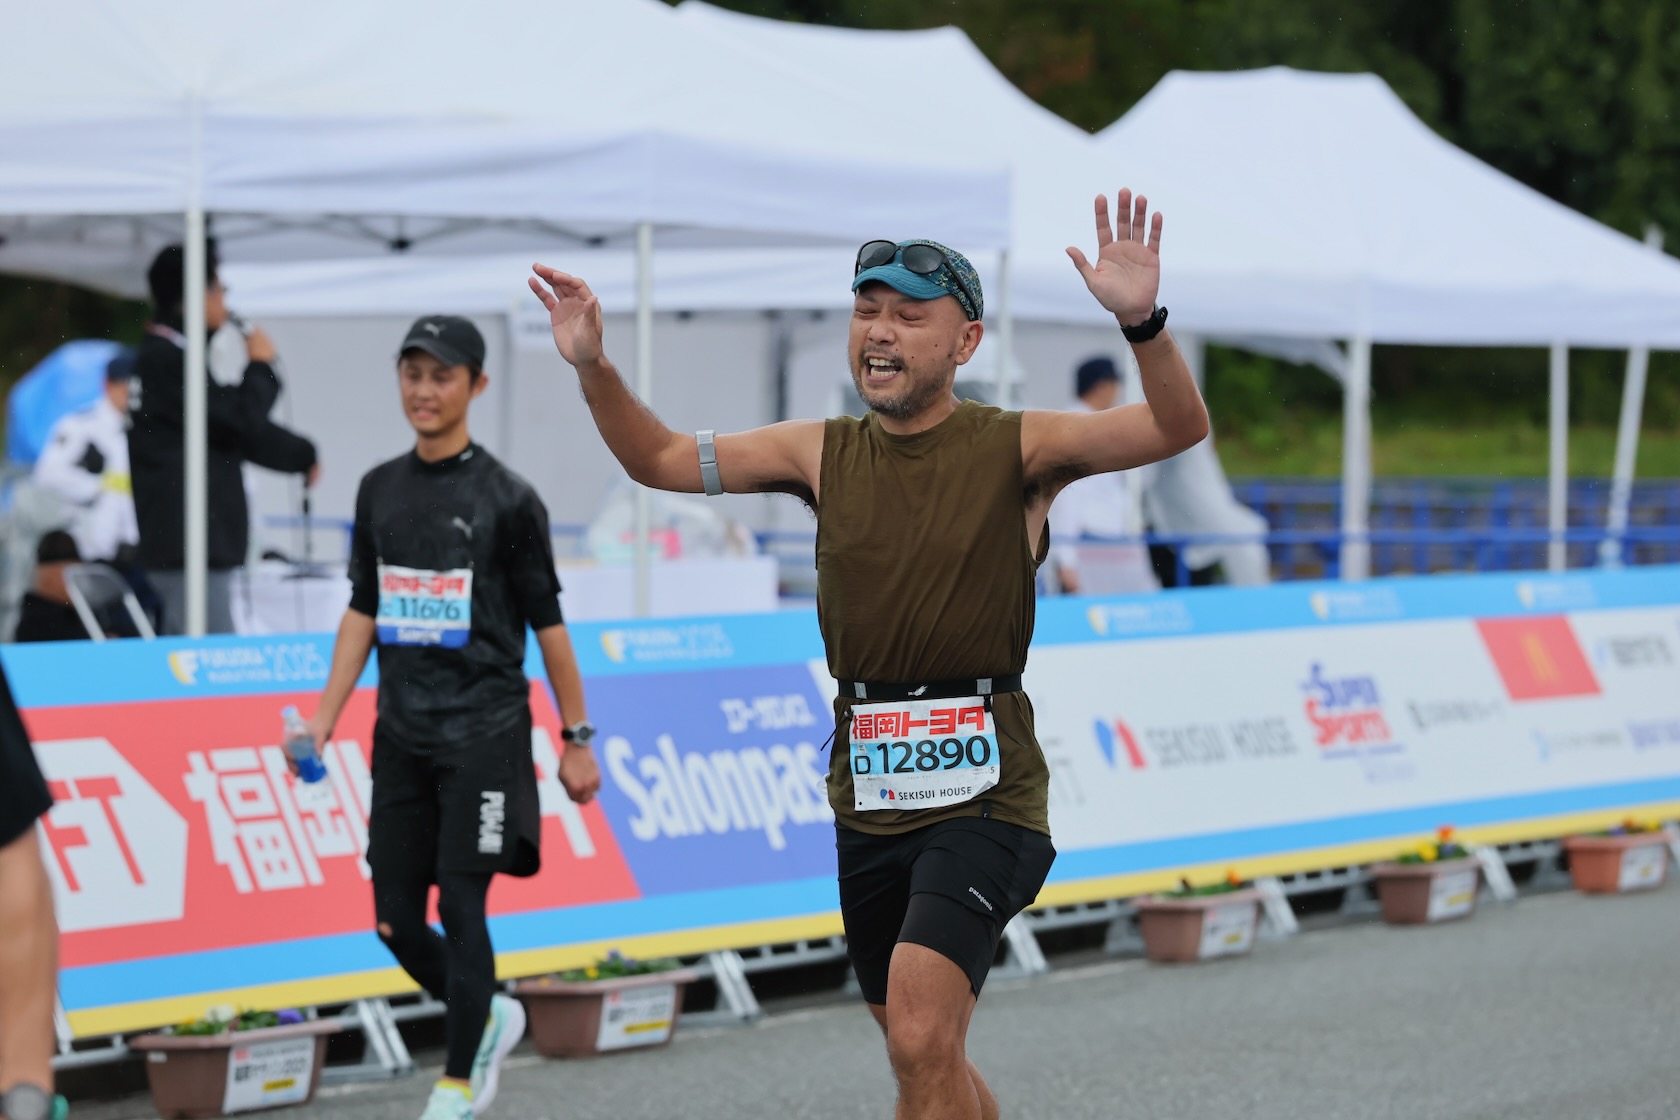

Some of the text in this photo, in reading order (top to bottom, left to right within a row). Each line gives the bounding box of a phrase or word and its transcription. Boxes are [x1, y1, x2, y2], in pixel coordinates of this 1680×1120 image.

[852, 705, 985, 740] 福岡トヨタ
[854, 735, 991, 775] D 12890
[898, 786, 972, 801] SEKISUI HOUSE
[968, 886, 993, 912] patagonia
